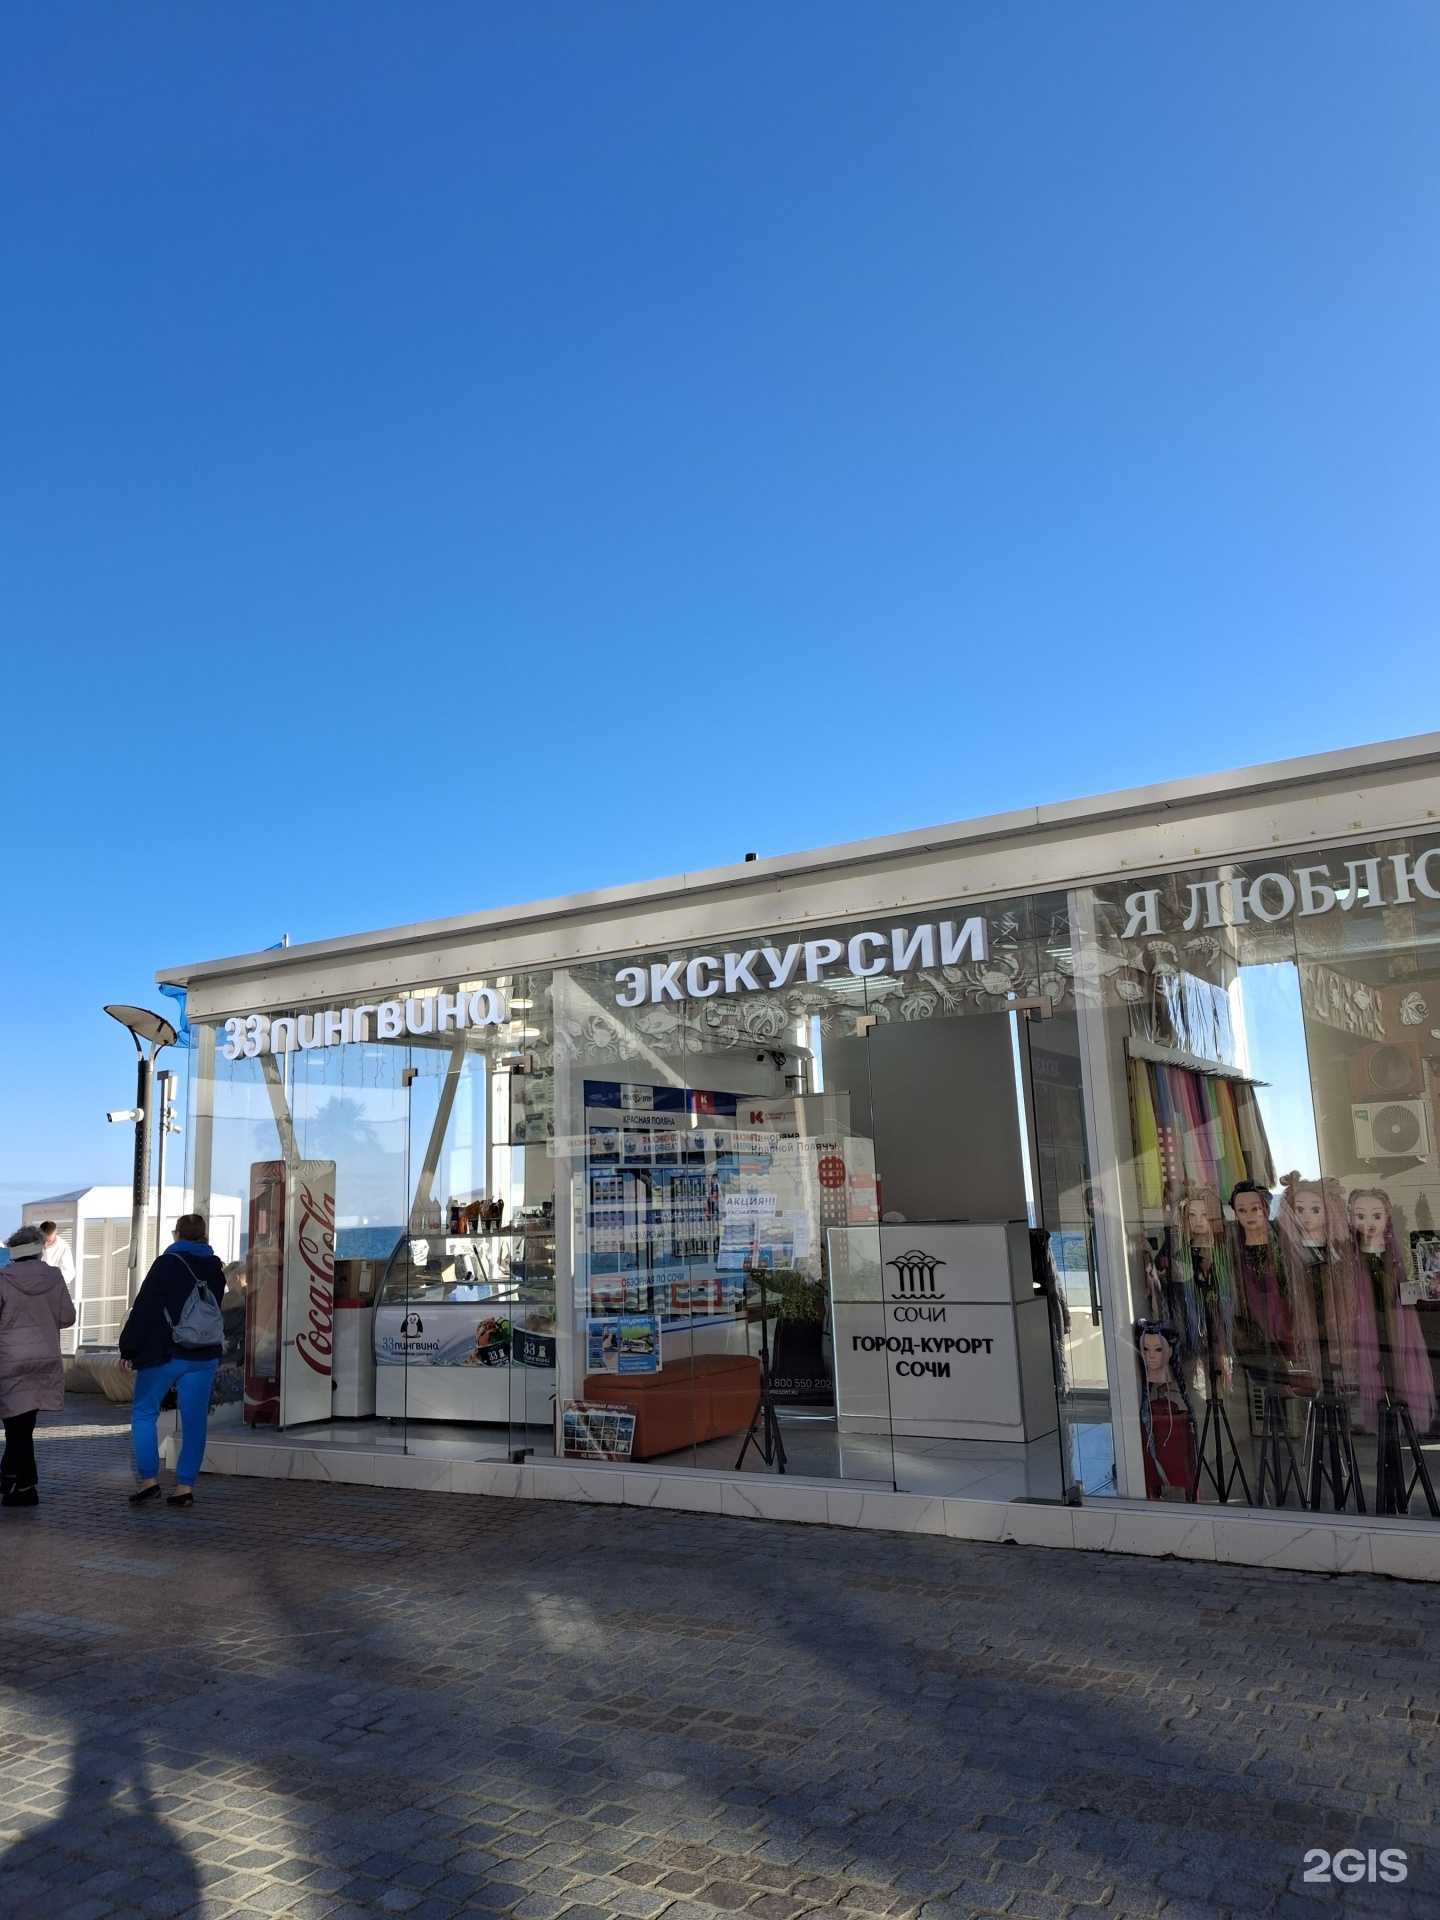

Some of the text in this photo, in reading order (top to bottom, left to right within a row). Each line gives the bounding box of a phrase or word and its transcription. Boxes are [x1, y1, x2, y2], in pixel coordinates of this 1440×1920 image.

[1121, 848, 1440, 939] Я ЛЮБЛЮ
[614, 916, 989, 1008] ЭКСКУРСИИ
[726, 1197, 775, 1207] АКЦИЯ!!!
[893, 1306, 947, 1323] СОЧИ
[852, 1335, 994, 1355] ГОРОД-КУРОРТ
[895, 1360, 951, 1378] СОЧИ
